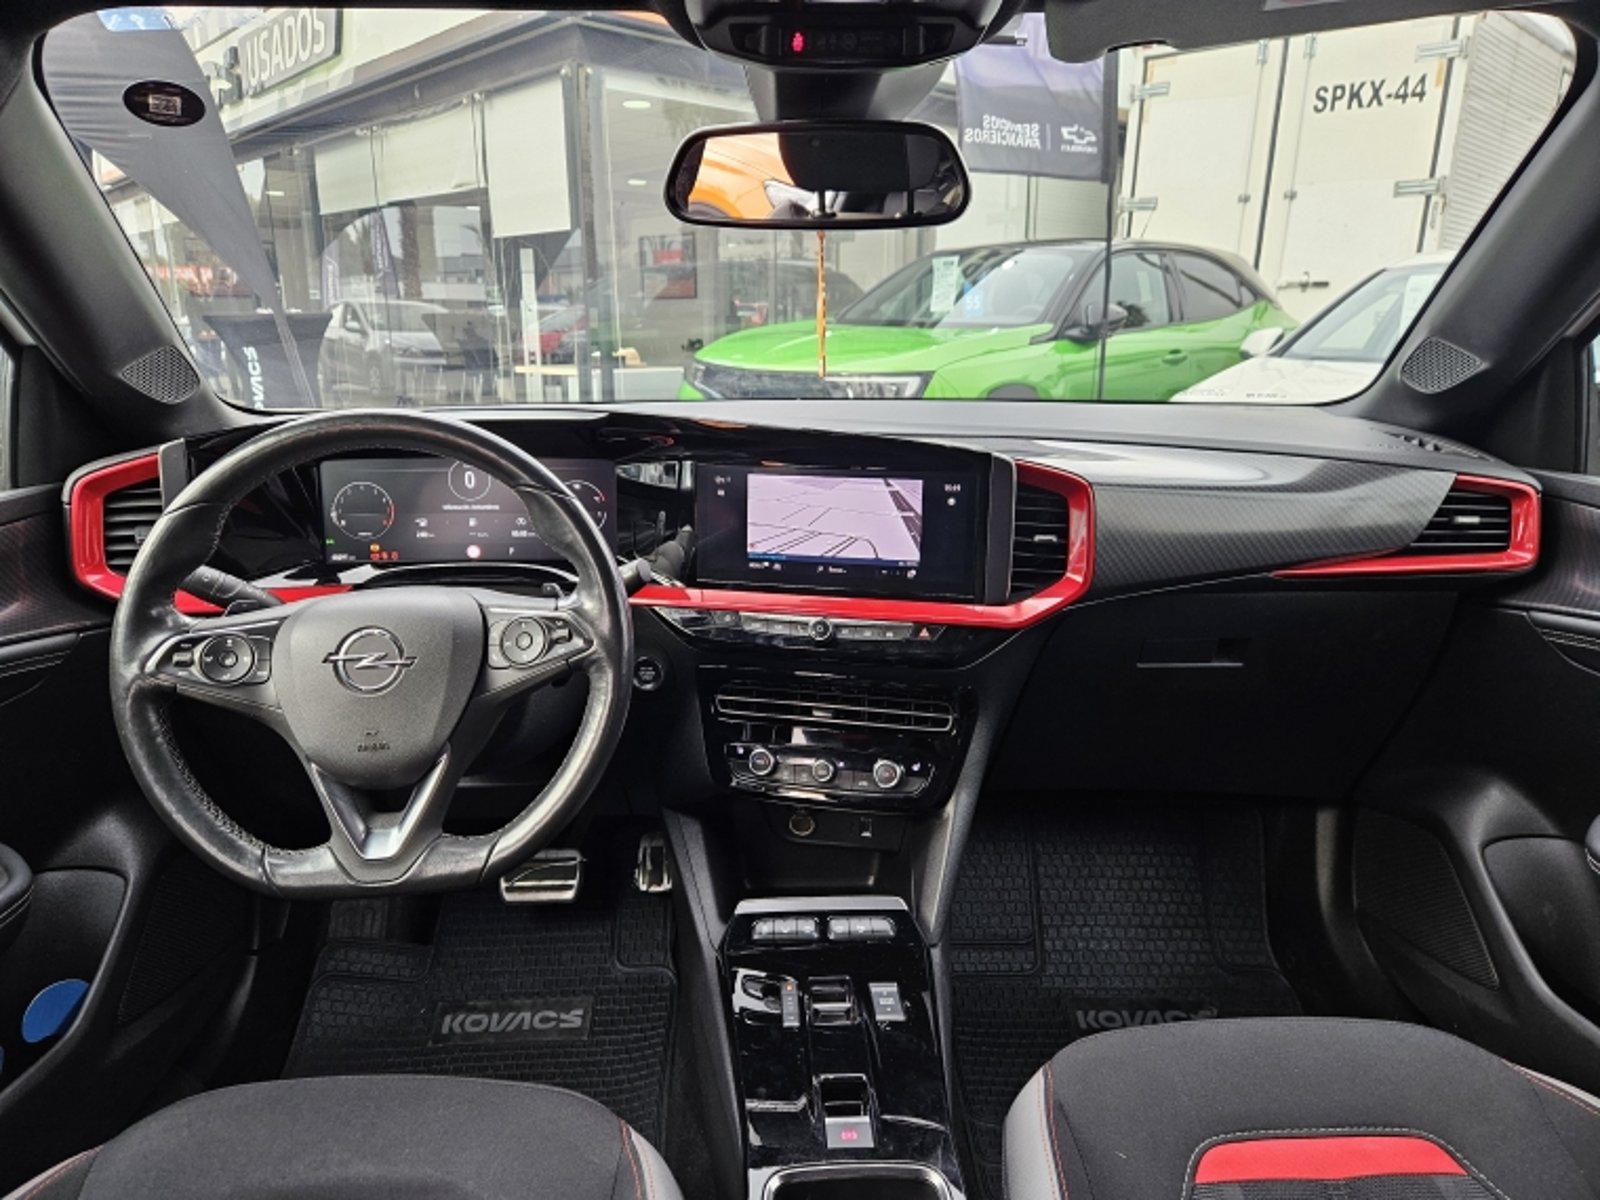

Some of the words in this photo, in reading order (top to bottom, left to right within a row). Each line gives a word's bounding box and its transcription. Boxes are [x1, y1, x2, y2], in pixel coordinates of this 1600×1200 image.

[245, 8, 326, 88] USADOS
[1312, 73, 1428, 114] SPKX-44
[242, 346, 264, 411] OVACS
[464, 470, 476, 490] 0
[441, 1008, 584, 1035] KOVACS
